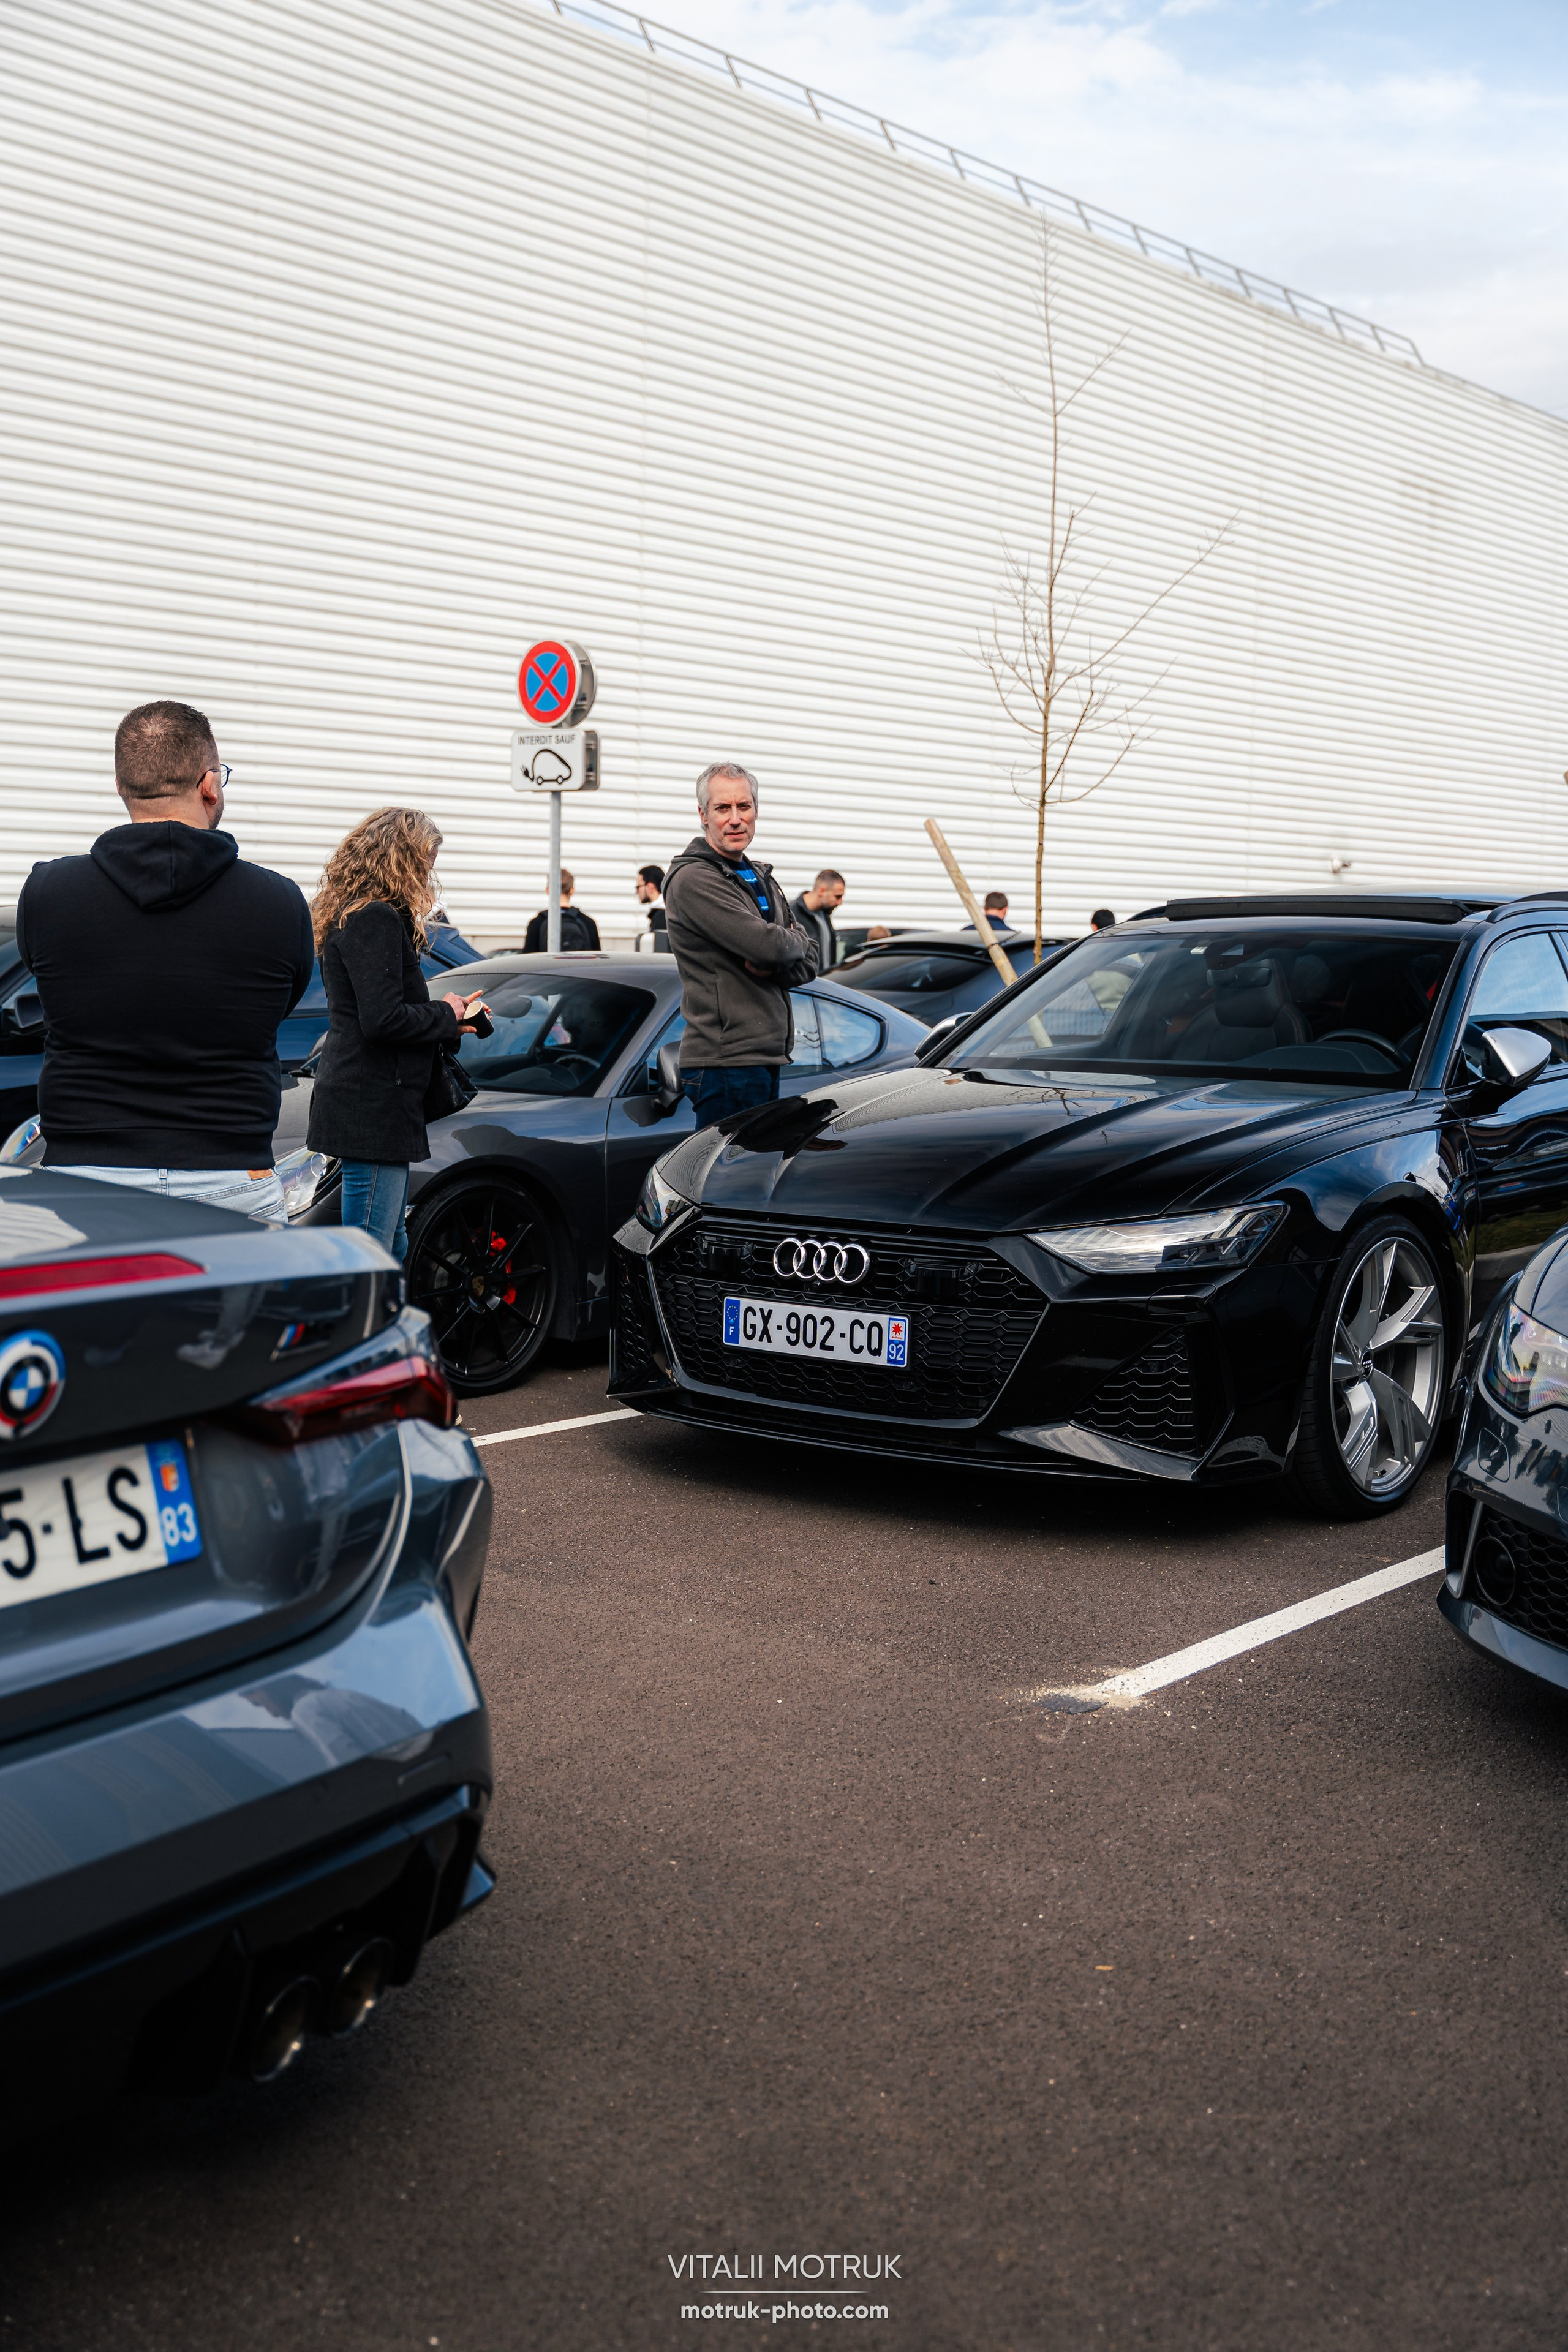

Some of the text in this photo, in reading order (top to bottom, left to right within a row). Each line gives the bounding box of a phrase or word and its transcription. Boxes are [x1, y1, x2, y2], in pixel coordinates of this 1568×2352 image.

[518, 734, 576, 745] INTERDIT SAUF
[729, 1326, 734, 1336] F
[742, 1306, 883, 1357] GX-902-CQ
[889, 1343, 904, 1360] 92
[161, 1502, 197, 1547] 83
